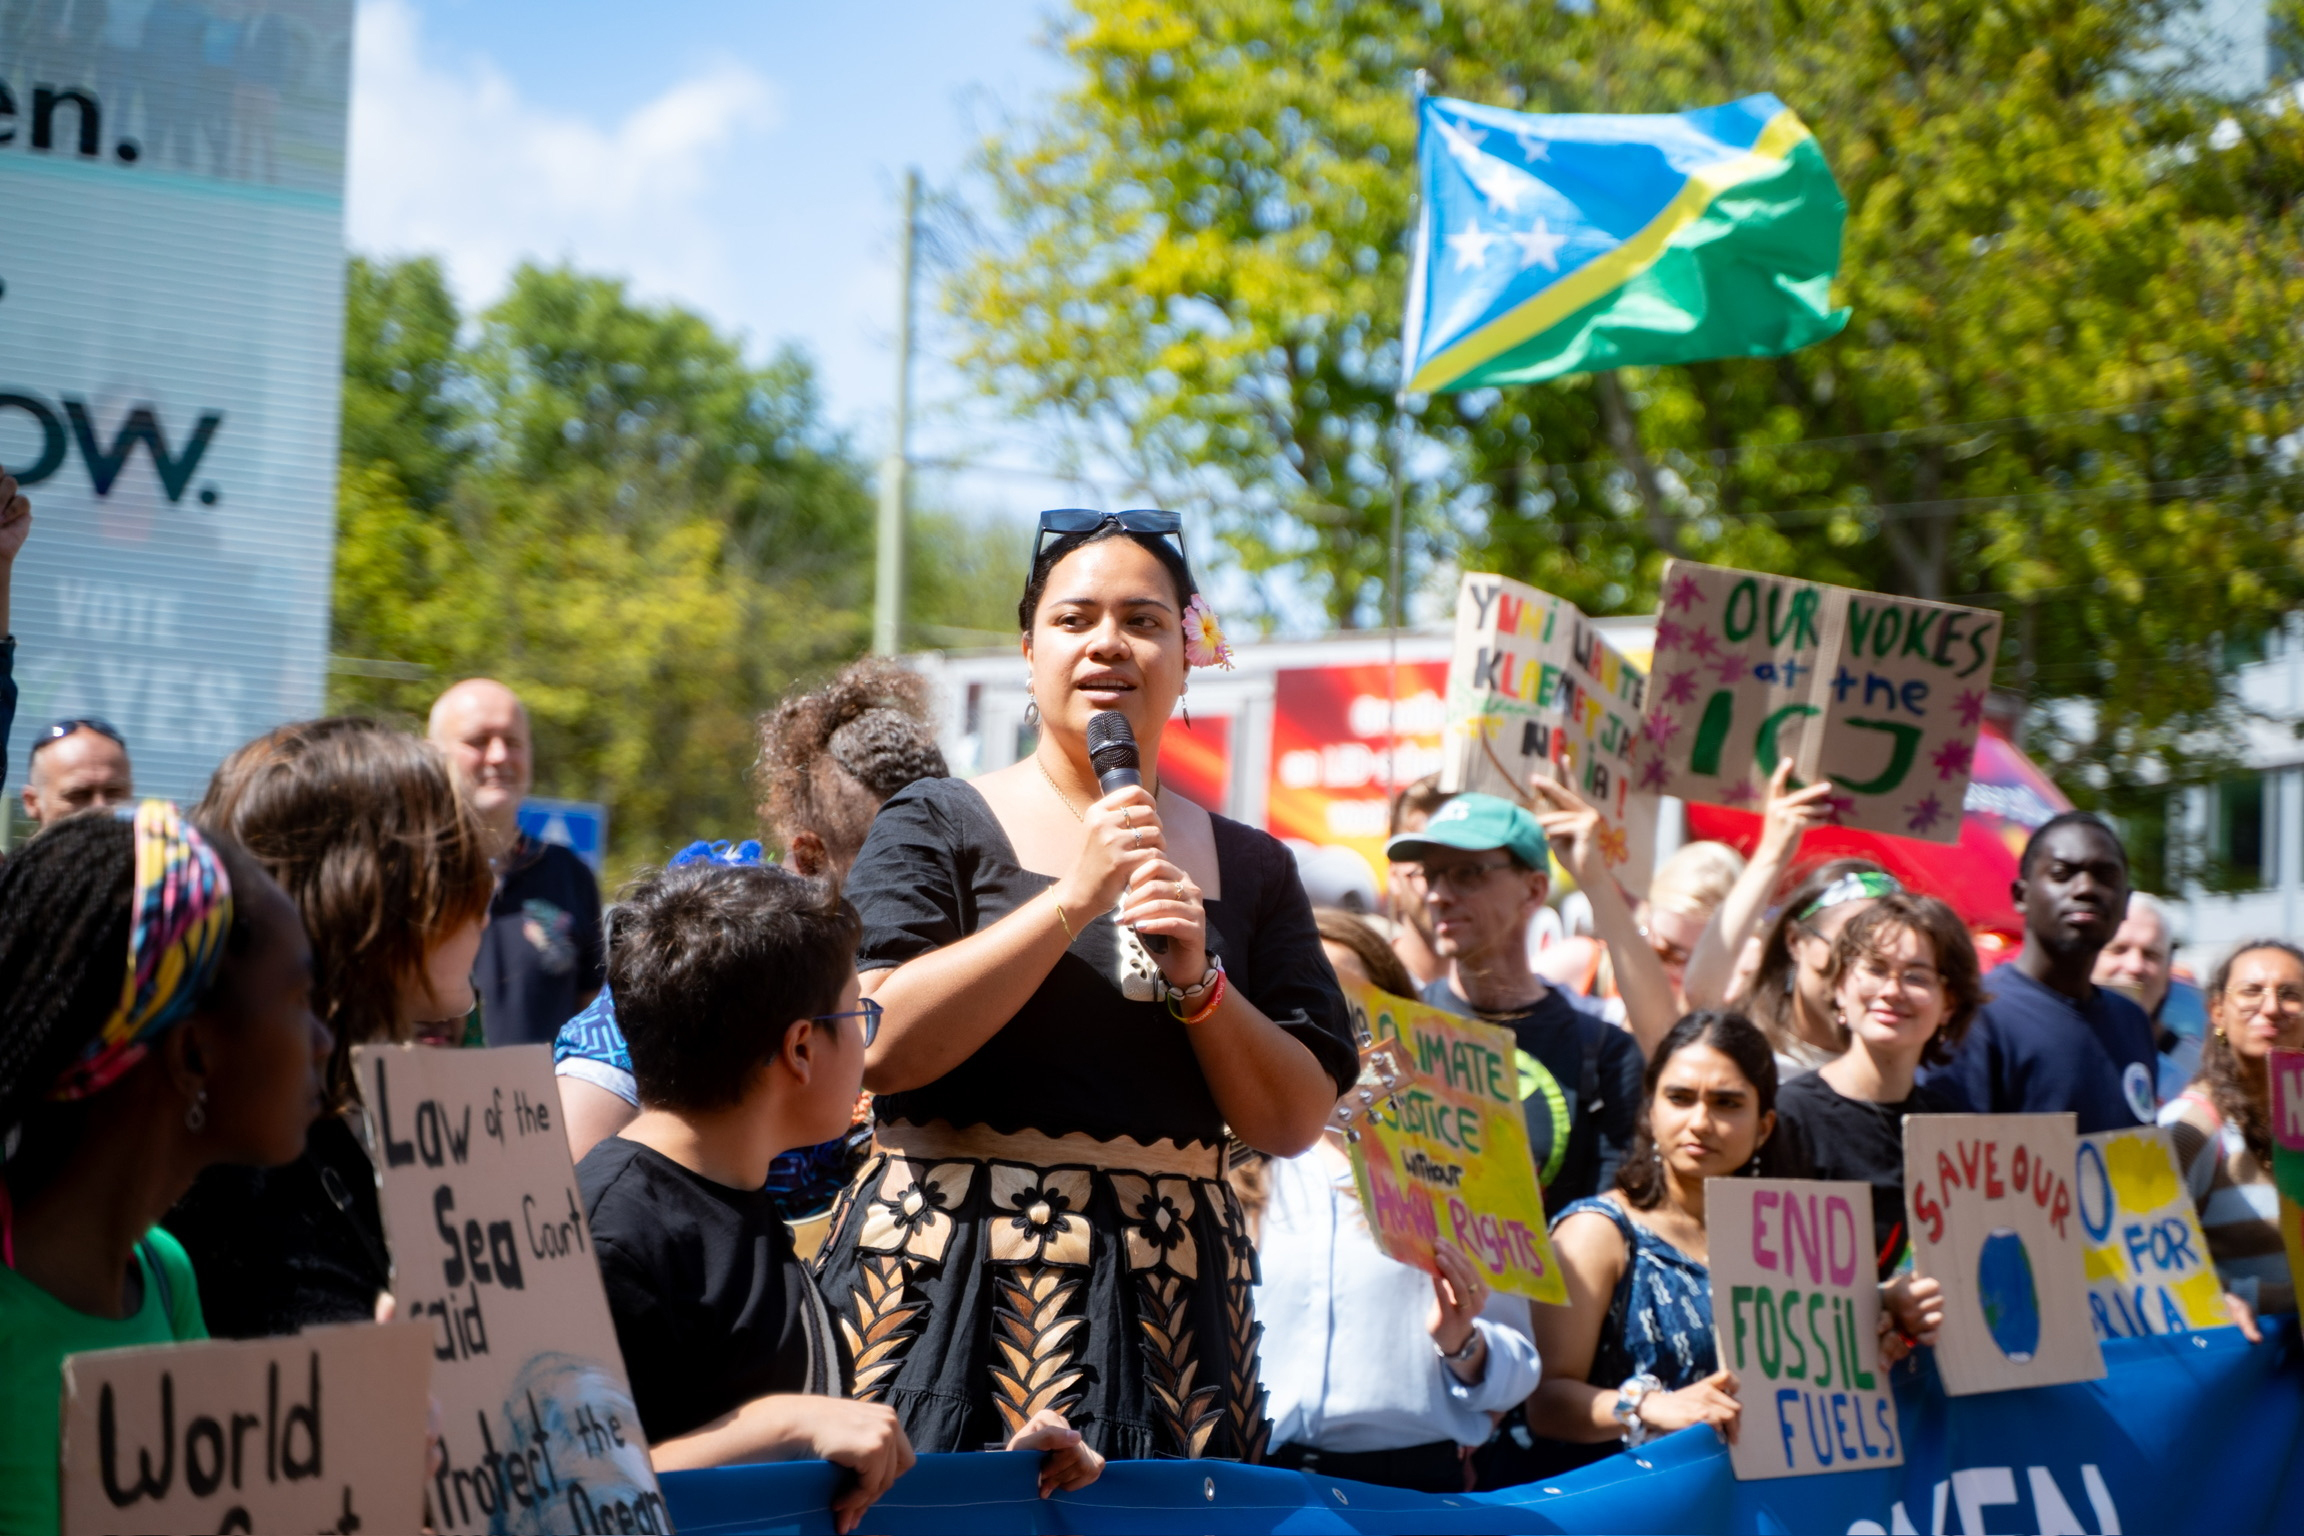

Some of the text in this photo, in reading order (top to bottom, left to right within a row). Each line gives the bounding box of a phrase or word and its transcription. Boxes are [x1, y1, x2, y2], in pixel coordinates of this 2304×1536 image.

[0, 80, 140, 162] n.
[1724, 576, 1820, 652] OUR
[1754, 658, 1808, 688] at
[1688, 688, 1925, 795] ICJ
[375, 1056, 552, 1169] Law of the
[434, 1184, 526, 1291] Sea
[1753, 1189, 1858, 1287] END
[1914, 1139, 2072, 1245] SAVE OUR
[2124, 1217, 2199, 1275] FOR
[410, 1281, 490, 1362] aid
[98, 1349, 323, 1508] World
[432, 1388, 560, 1531] Protect
[574, 1402, 626, 1460] the
[1776, 1388, 1896, 1469] FUELS
